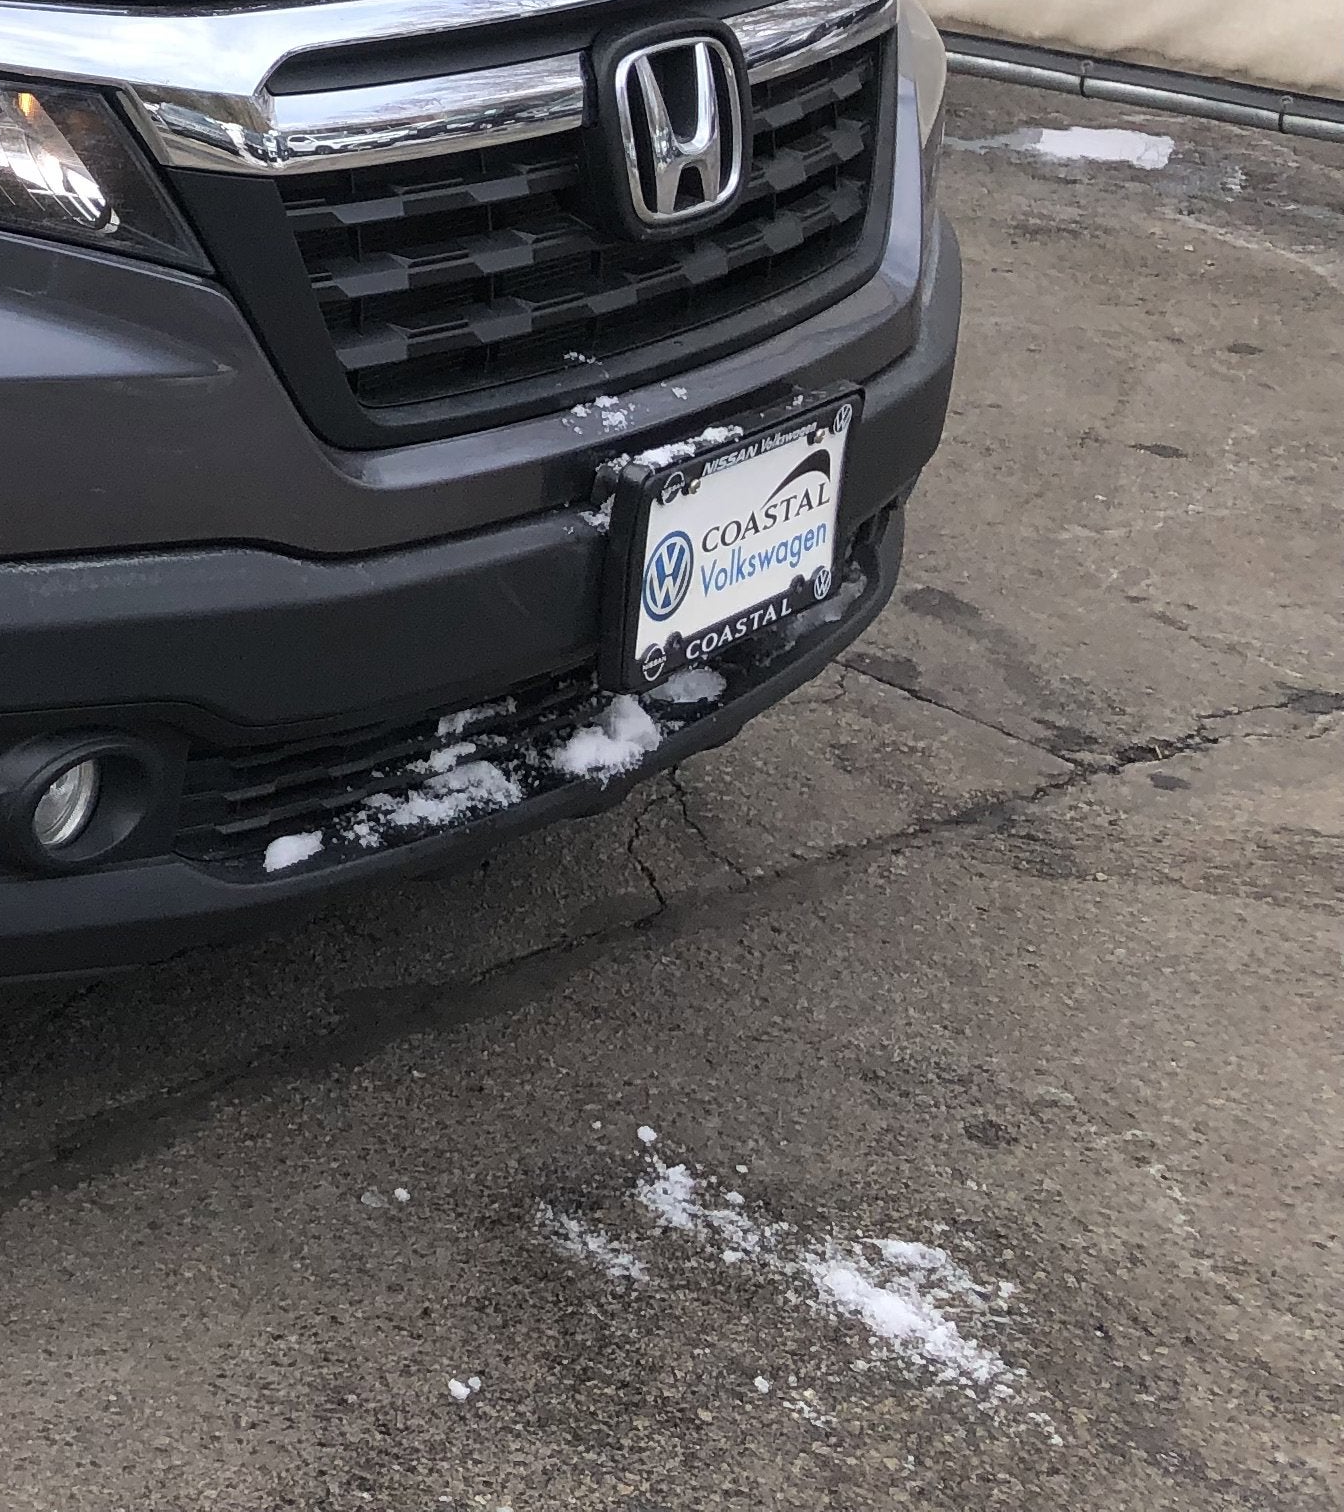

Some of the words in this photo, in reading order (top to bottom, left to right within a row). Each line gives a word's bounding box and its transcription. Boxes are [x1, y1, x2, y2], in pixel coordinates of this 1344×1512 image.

[702, 443, 759, 477] NISSAN
[701, 482, 831, 553] COASTAL
[700, 522, 827, 597] Volkswagen
[685, 598, 792, 660] COASTAL
